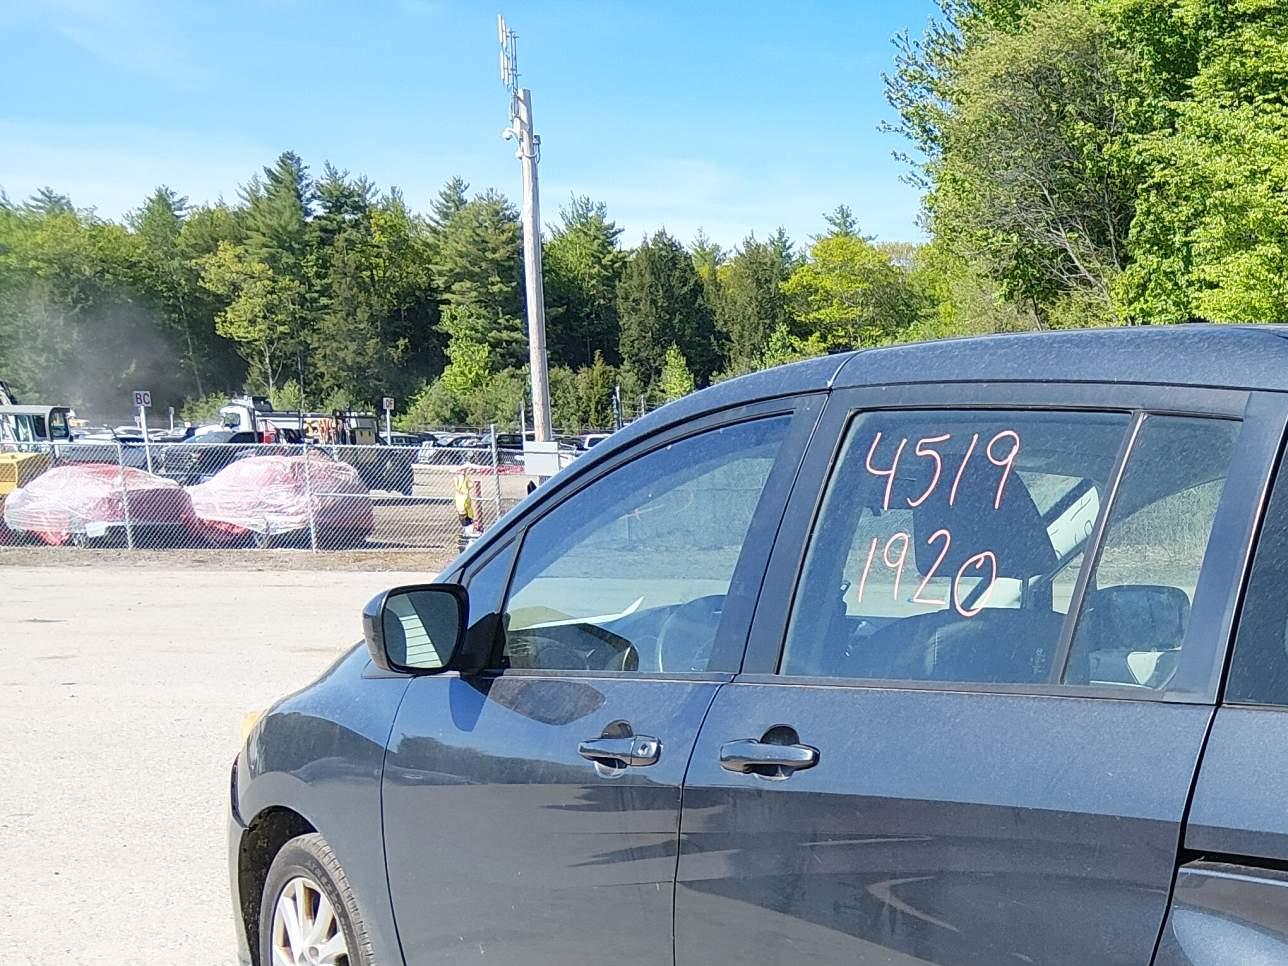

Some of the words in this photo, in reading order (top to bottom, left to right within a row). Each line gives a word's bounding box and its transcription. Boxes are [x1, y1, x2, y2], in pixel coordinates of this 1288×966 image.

[136, 392, 150, 405] BC
[864, 430, 1020, 511] 4519
[857, 529, 997, 617] 1920
